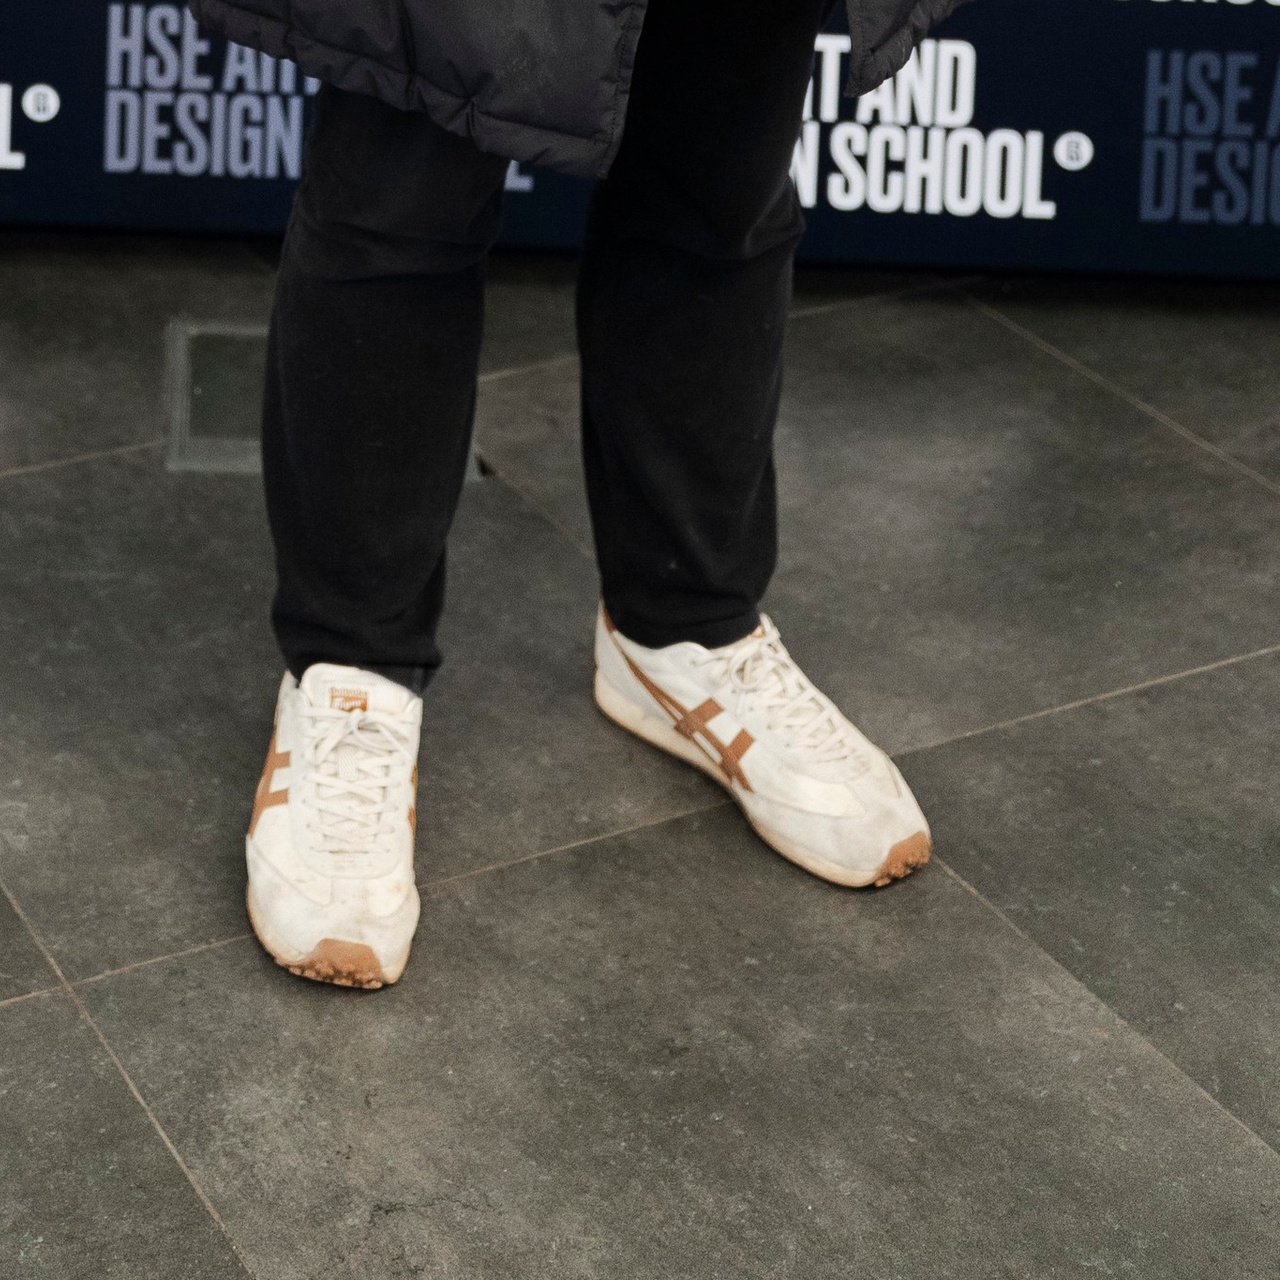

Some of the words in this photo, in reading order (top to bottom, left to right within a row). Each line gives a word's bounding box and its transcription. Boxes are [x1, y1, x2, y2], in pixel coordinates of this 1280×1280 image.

[106, 2, 215, 91] HSE
[103, 89, 305, 180] DESIGN
[1144, 49, 1259, 137] HSE
[826, 121, 1057, 220] SCHOOL
[1139, 137, 1280, 227] DESI
